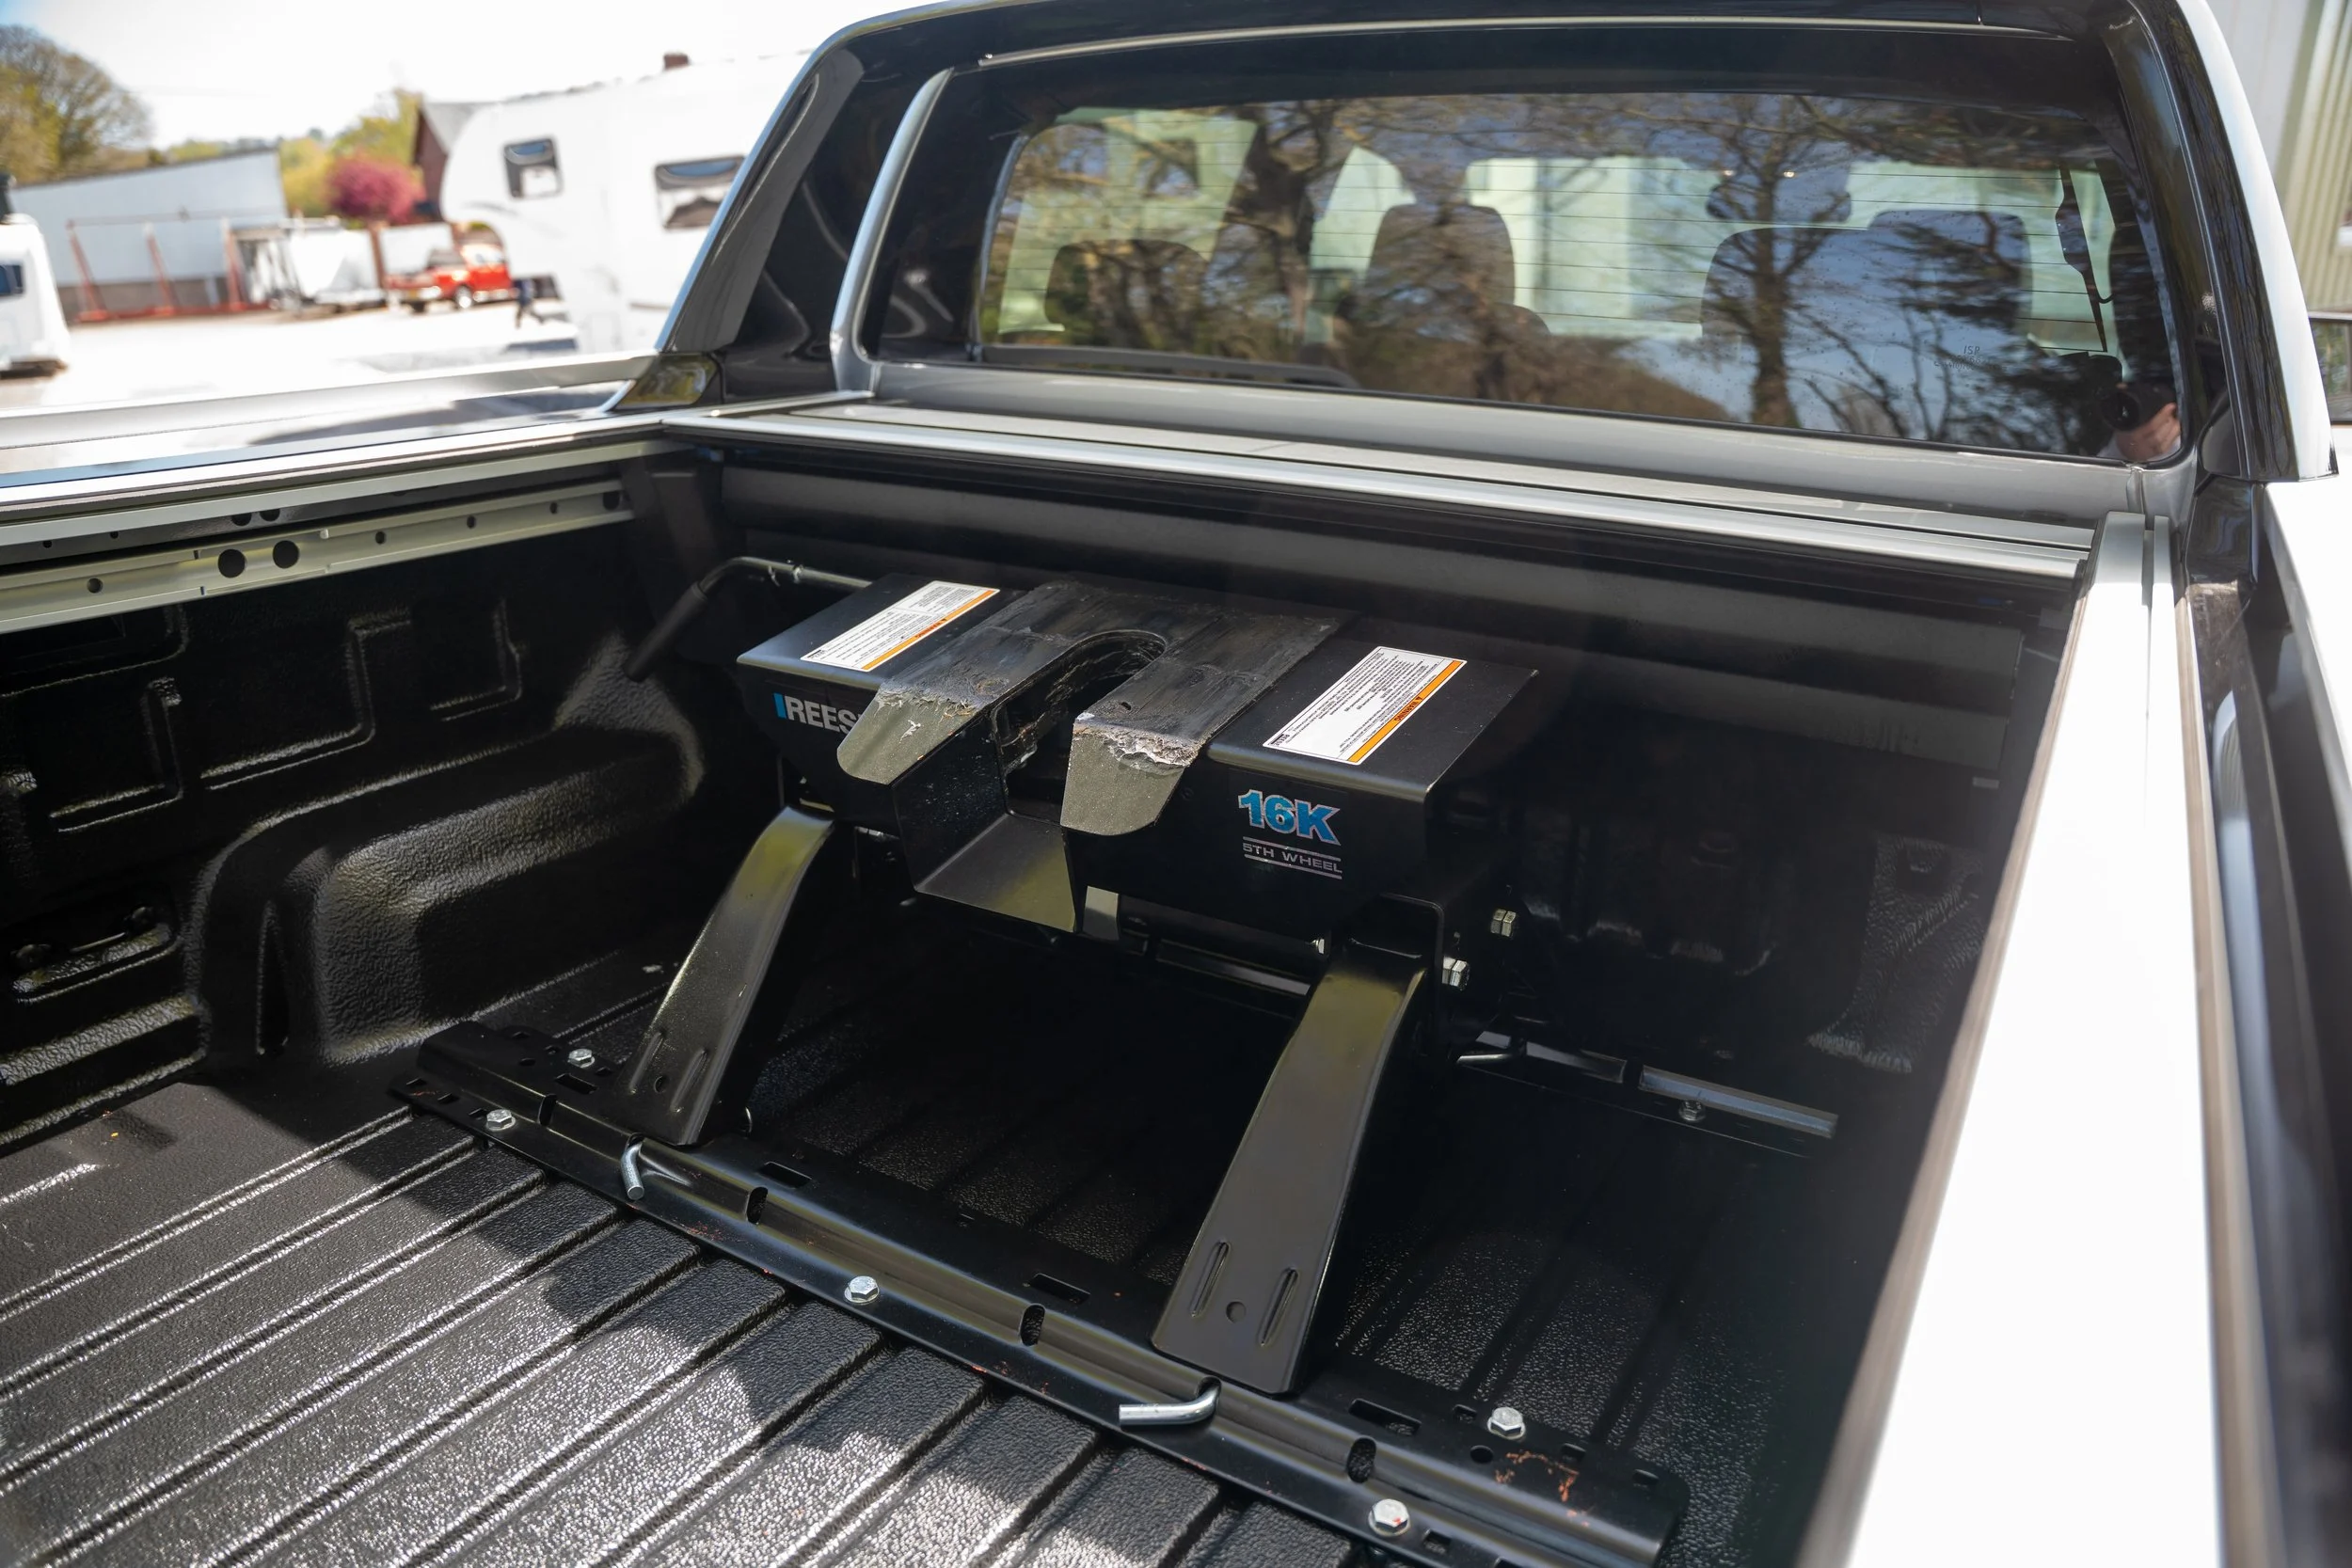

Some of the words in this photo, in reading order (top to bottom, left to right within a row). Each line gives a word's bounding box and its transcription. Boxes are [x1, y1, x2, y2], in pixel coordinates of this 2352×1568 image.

[785, 695, 862, 735] REES
[1394, 701, 1418, 721] WARNING
[1238, 789, 1342, 846] 16K
[1243, 842, 1275, 858] 5TH
[1281, 851, 1343, 874] WHEEL
